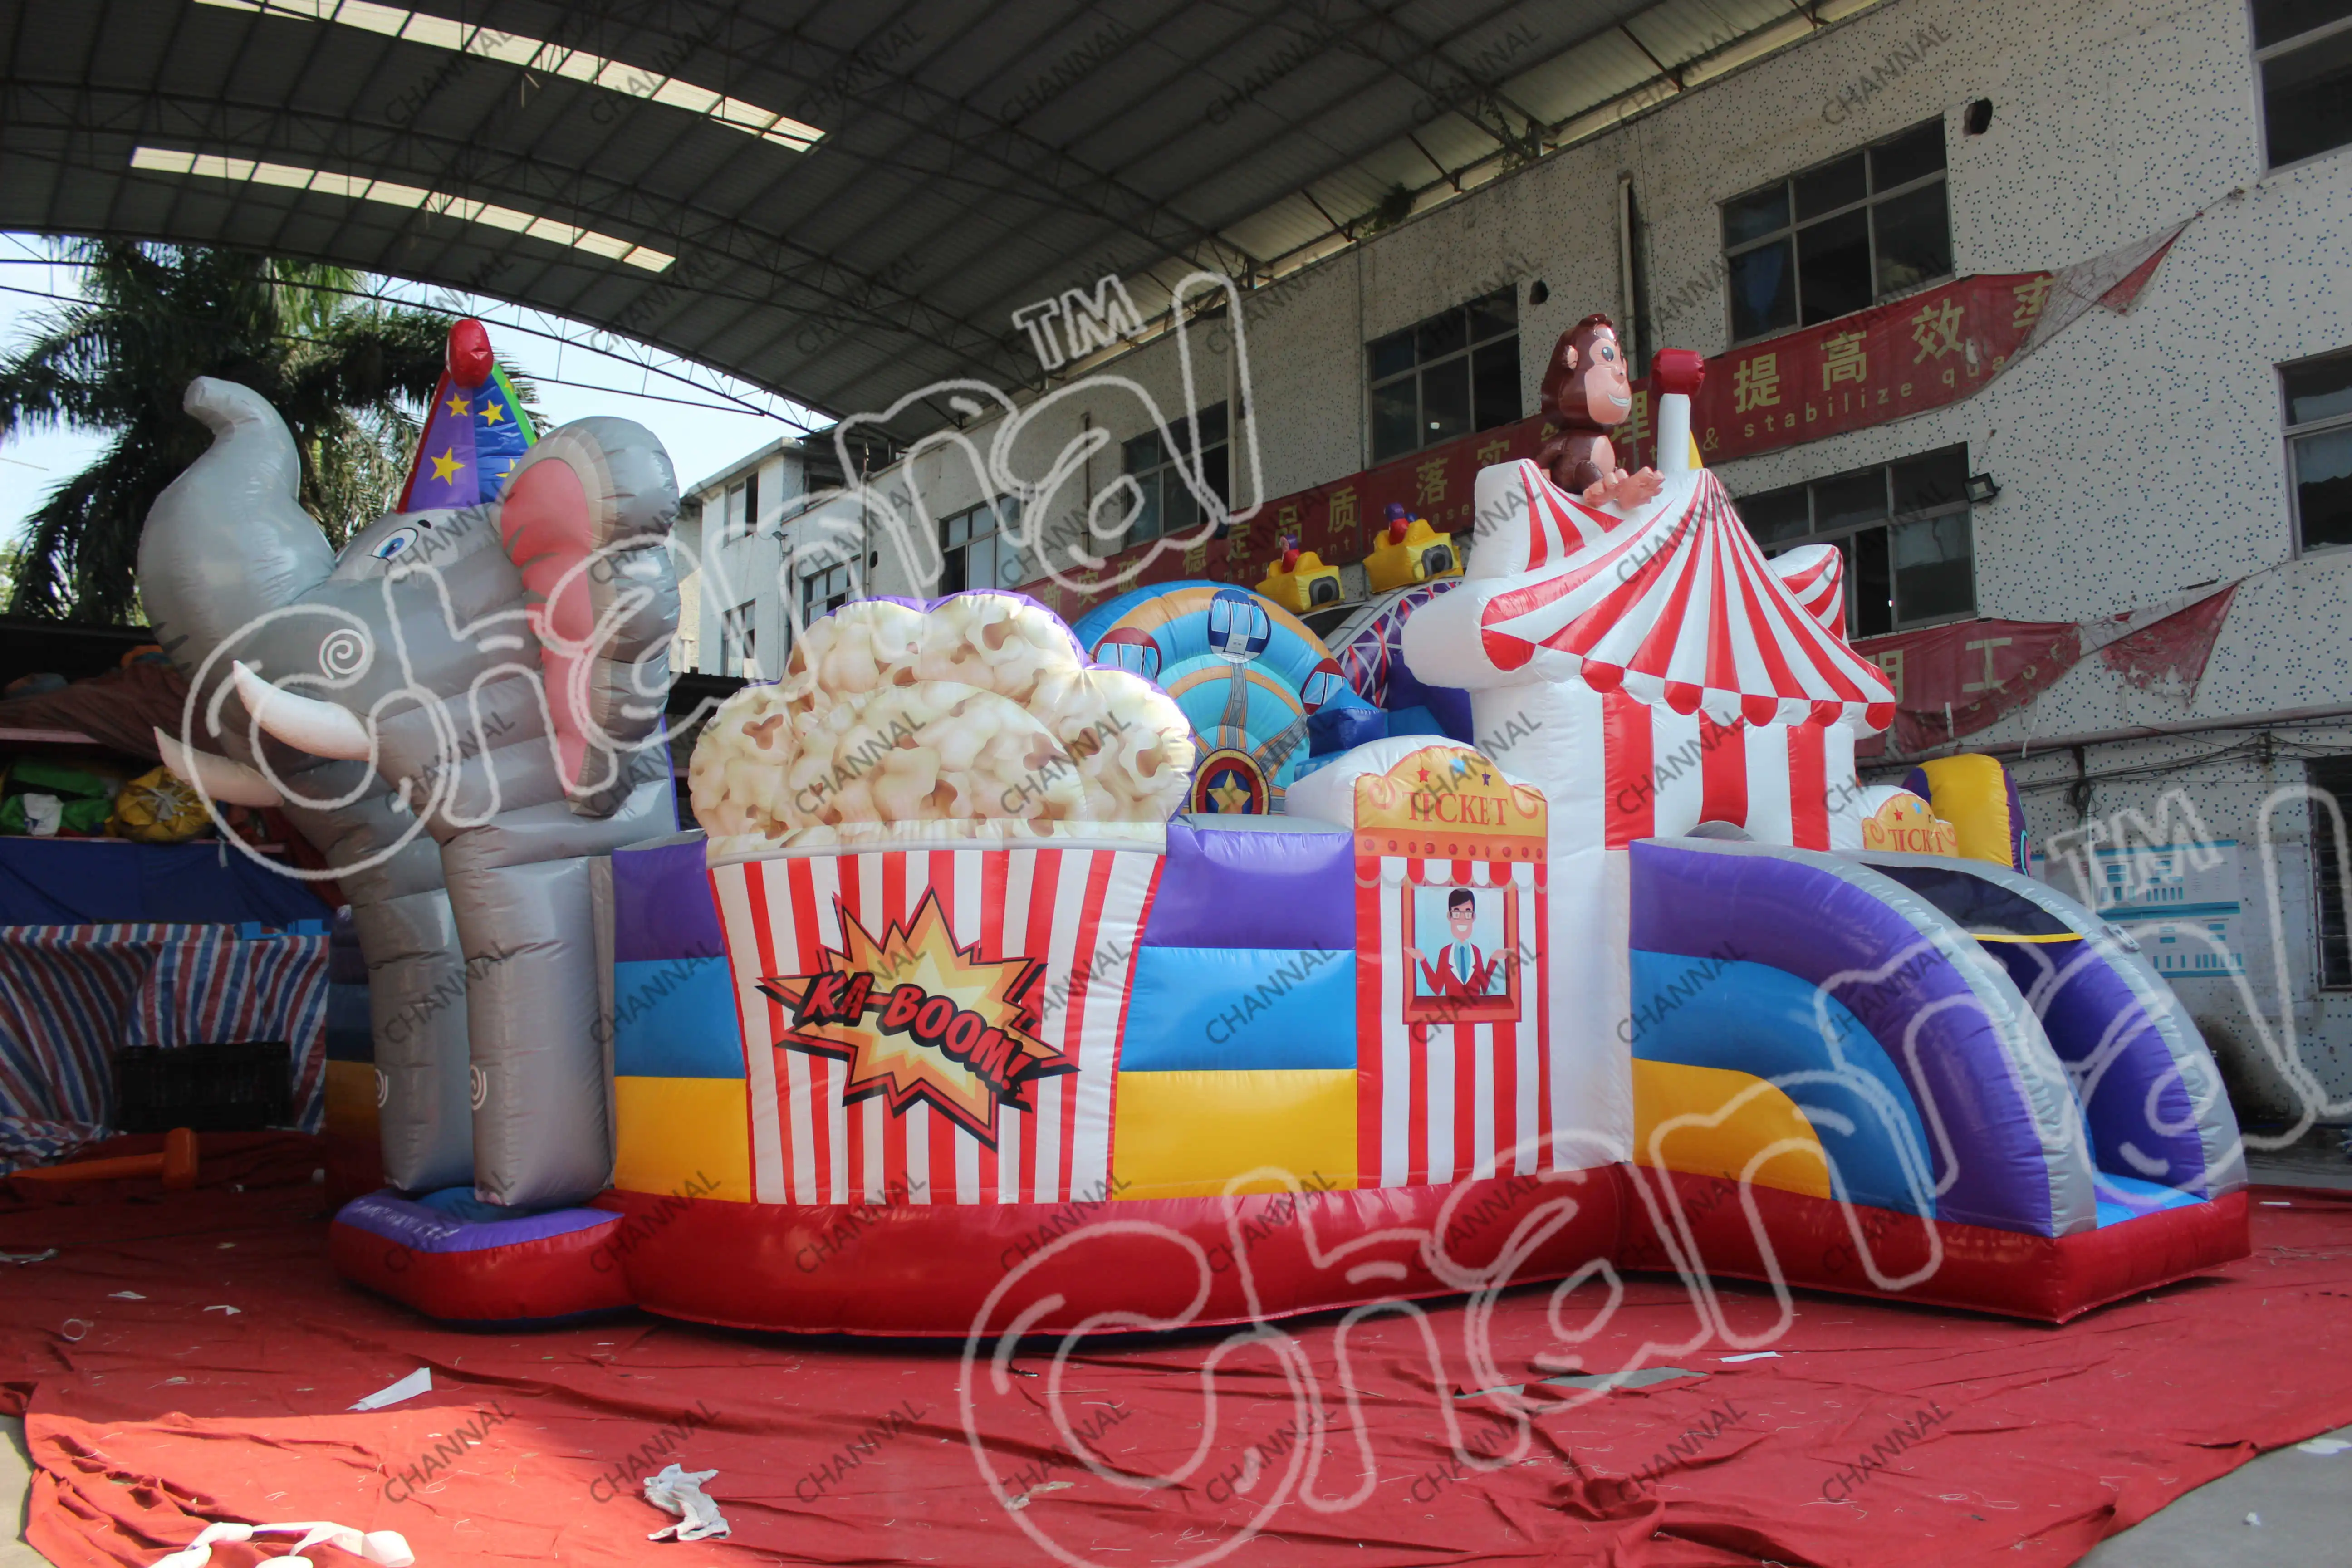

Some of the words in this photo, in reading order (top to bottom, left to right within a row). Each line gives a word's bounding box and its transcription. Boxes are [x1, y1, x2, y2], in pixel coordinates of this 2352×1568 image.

[1733, 275, 2054, 414] 提高效率
[1703, 427, 1719, 451] &
[1744, 382, 1912, 437] stabilize
[1402, 791, 1509, 826] TICKET
[1888, 828, 1944, 853] TICKT
[795, 971, 1036, 1091] KA-BOOM!
